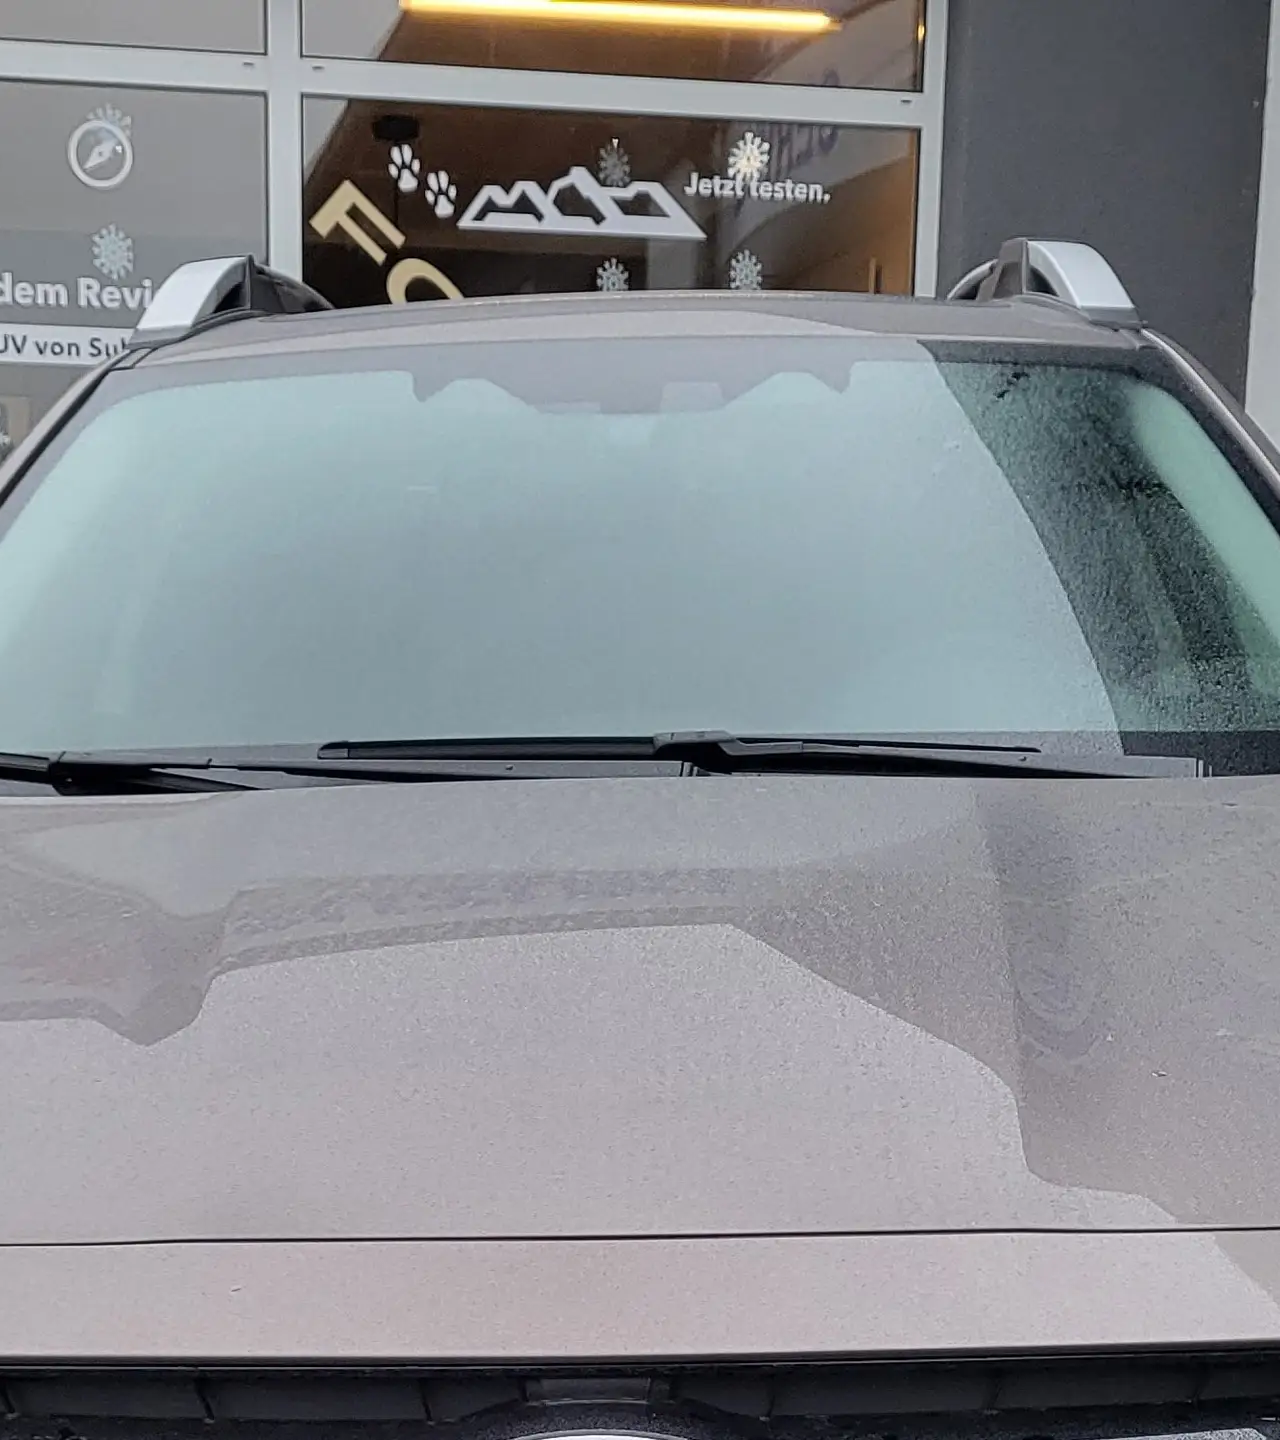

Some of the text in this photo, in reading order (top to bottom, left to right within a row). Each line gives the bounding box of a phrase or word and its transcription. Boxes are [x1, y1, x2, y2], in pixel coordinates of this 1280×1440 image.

[683, 171, 831, 203] Jetzt testen.
[35, 338, 80, 357] von
